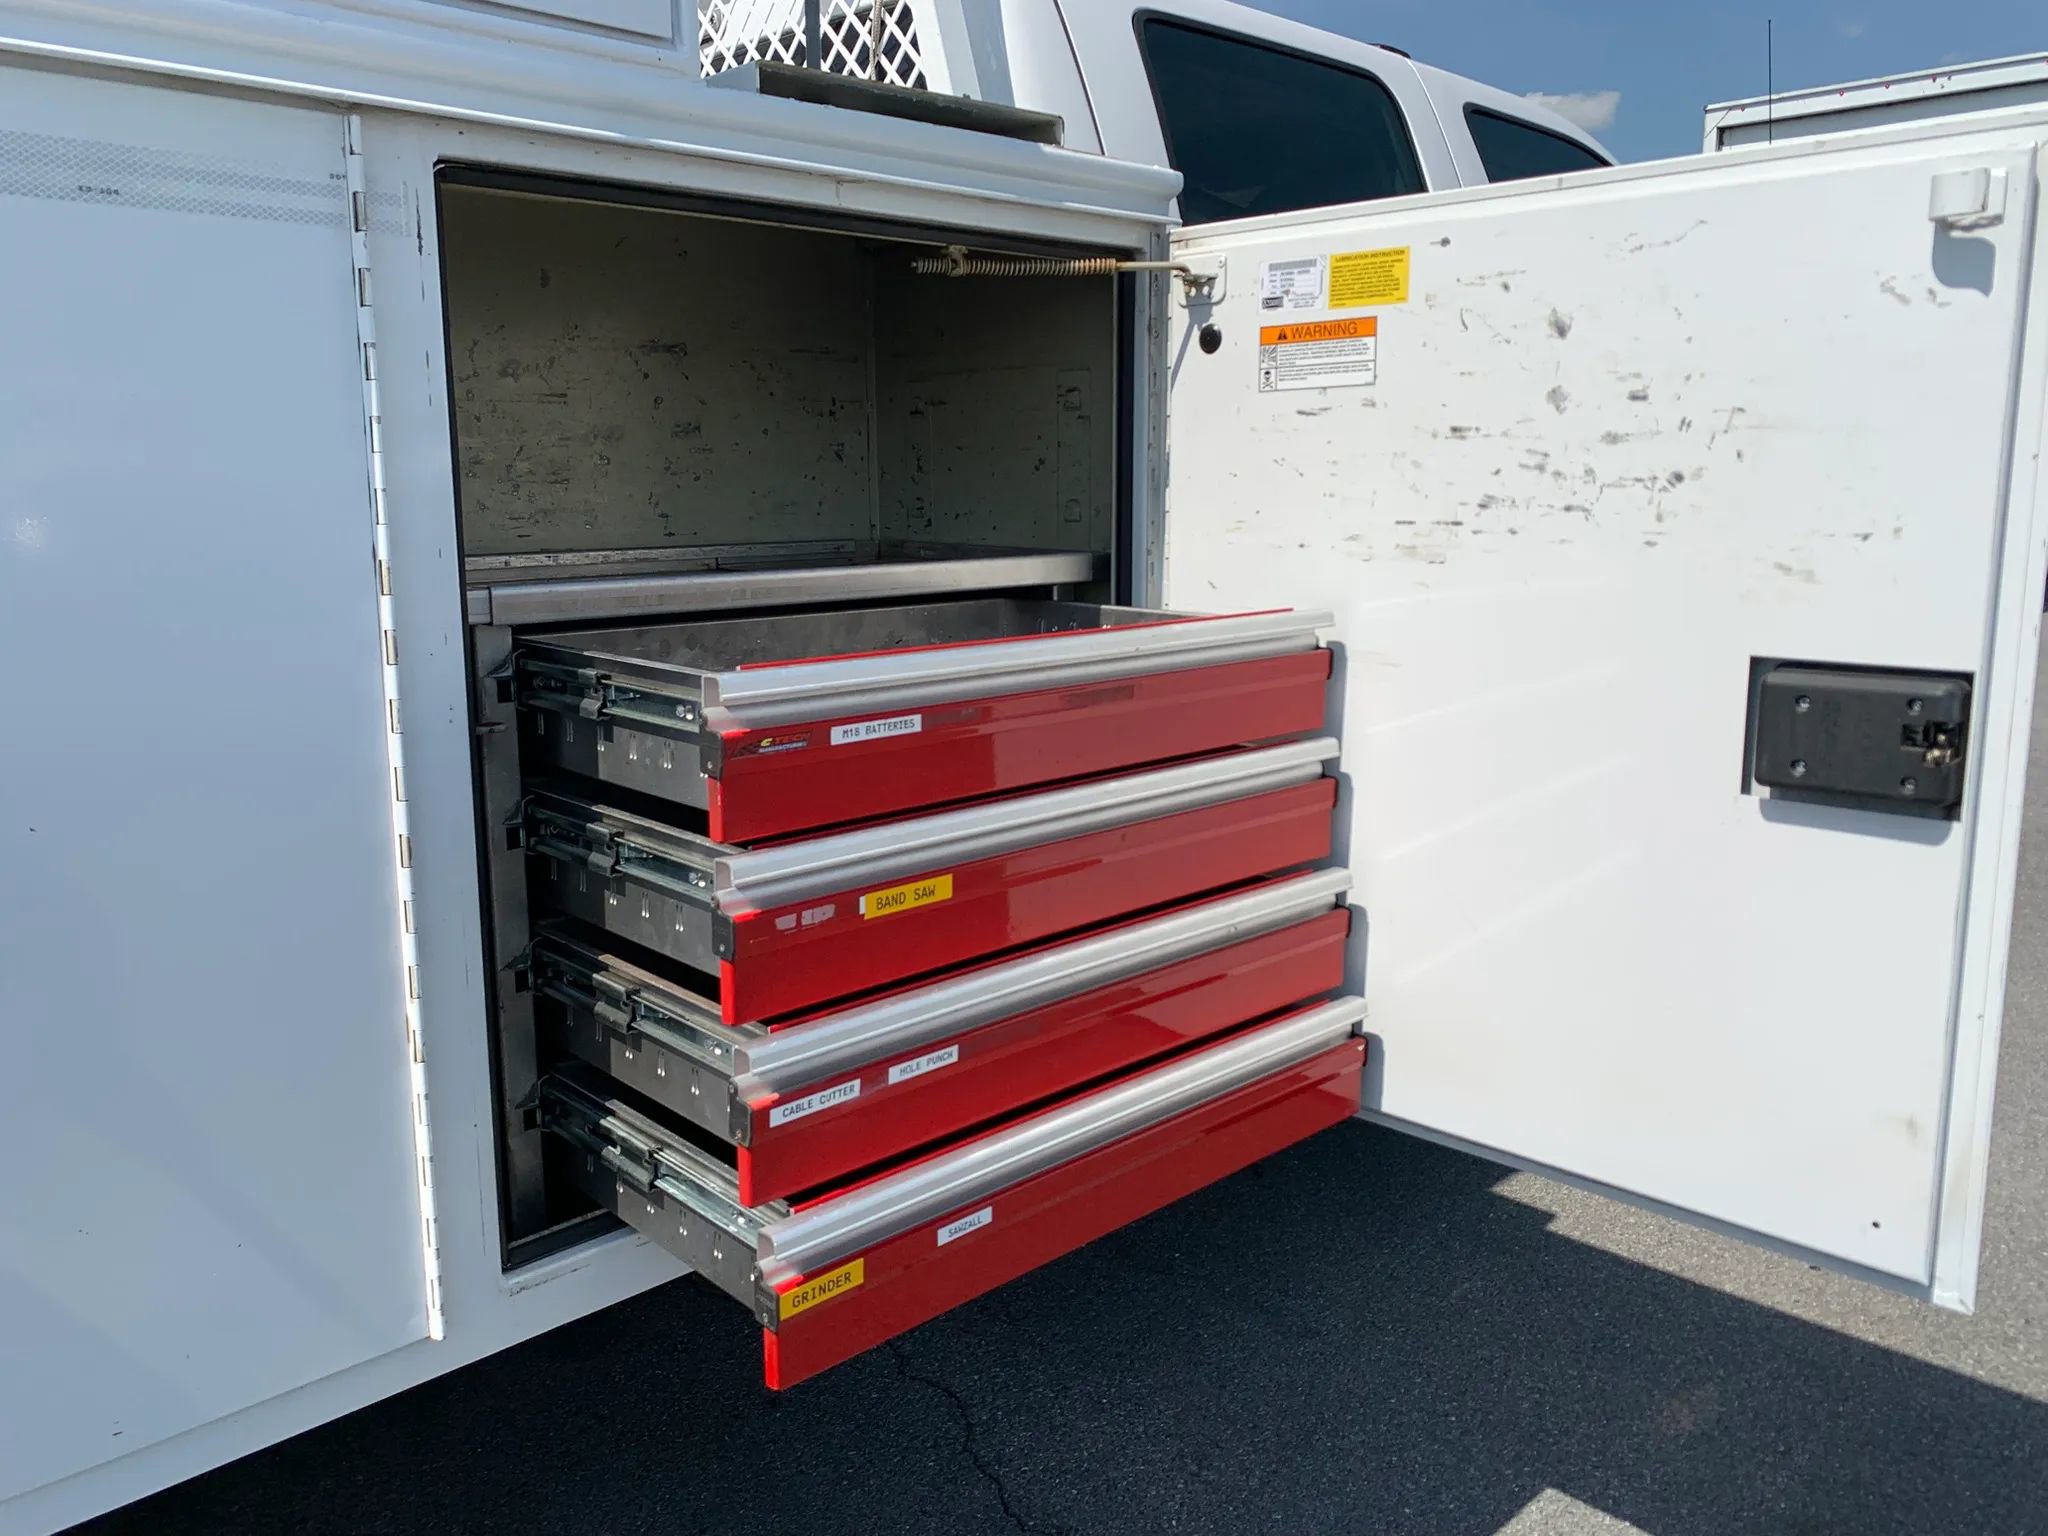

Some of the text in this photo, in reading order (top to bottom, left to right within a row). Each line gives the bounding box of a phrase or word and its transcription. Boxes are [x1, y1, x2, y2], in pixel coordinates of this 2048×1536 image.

[1291, 321, 1358, 340] WARNING
[842, 718, 916, 739] M18 BATTERIES
[876, 885, 937, 911] BAND SAW
[899, 1050, 954, 1077] HOLE PUNCH
[782, 1084, 855, 1118] CABLE CUTTER
[947, 1215, 984, 1238] SAWZALL
[792, 1271, 853, 1309] GRINDER
